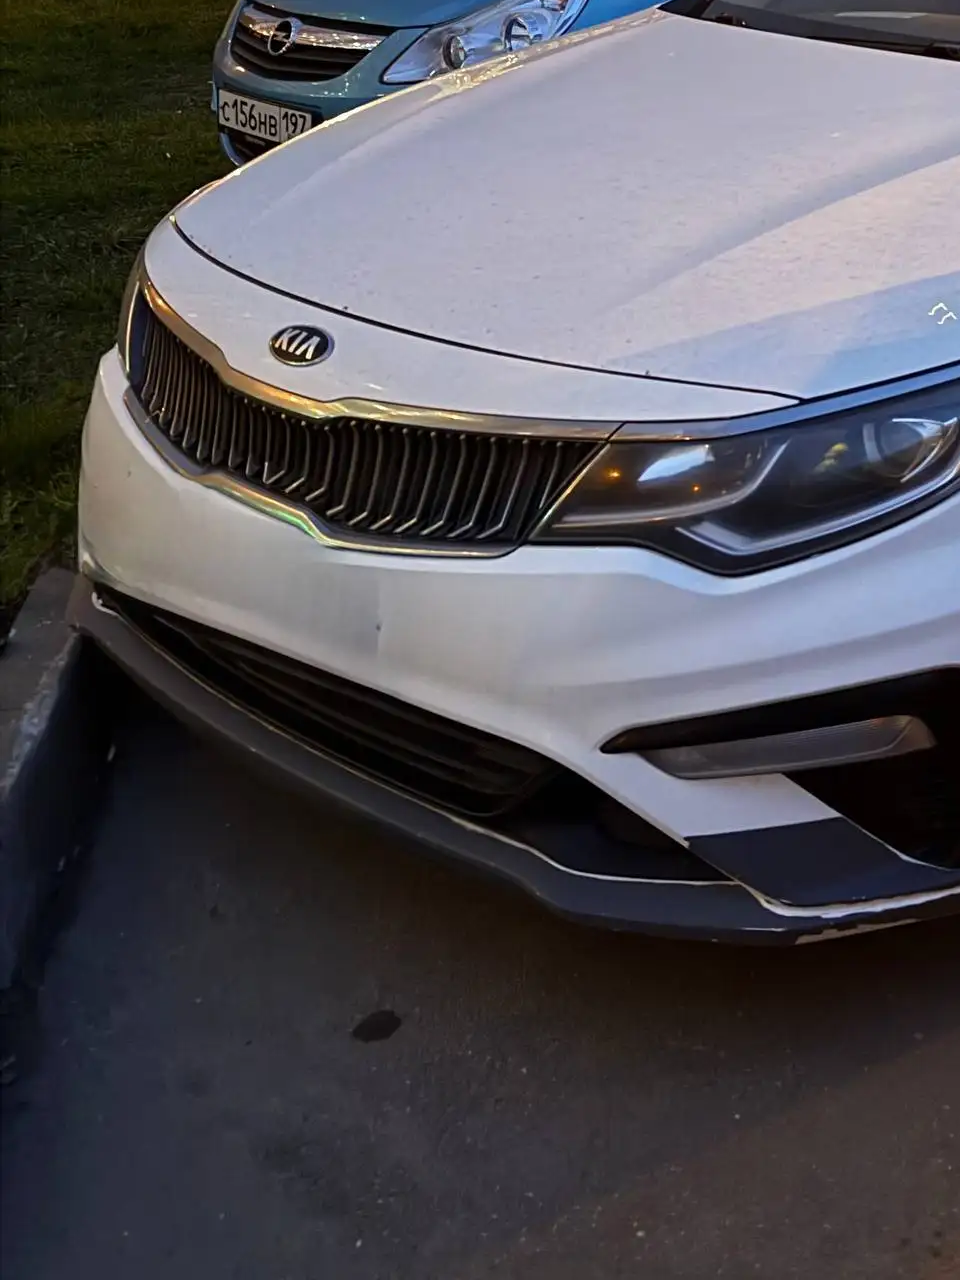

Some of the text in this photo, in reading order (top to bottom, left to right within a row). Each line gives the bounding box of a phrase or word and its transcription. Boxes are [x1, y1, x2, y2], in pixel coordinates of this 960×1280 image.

[222, 99, 307, 137] С156НВ 197
[274, 327, 321, 360] KIA
